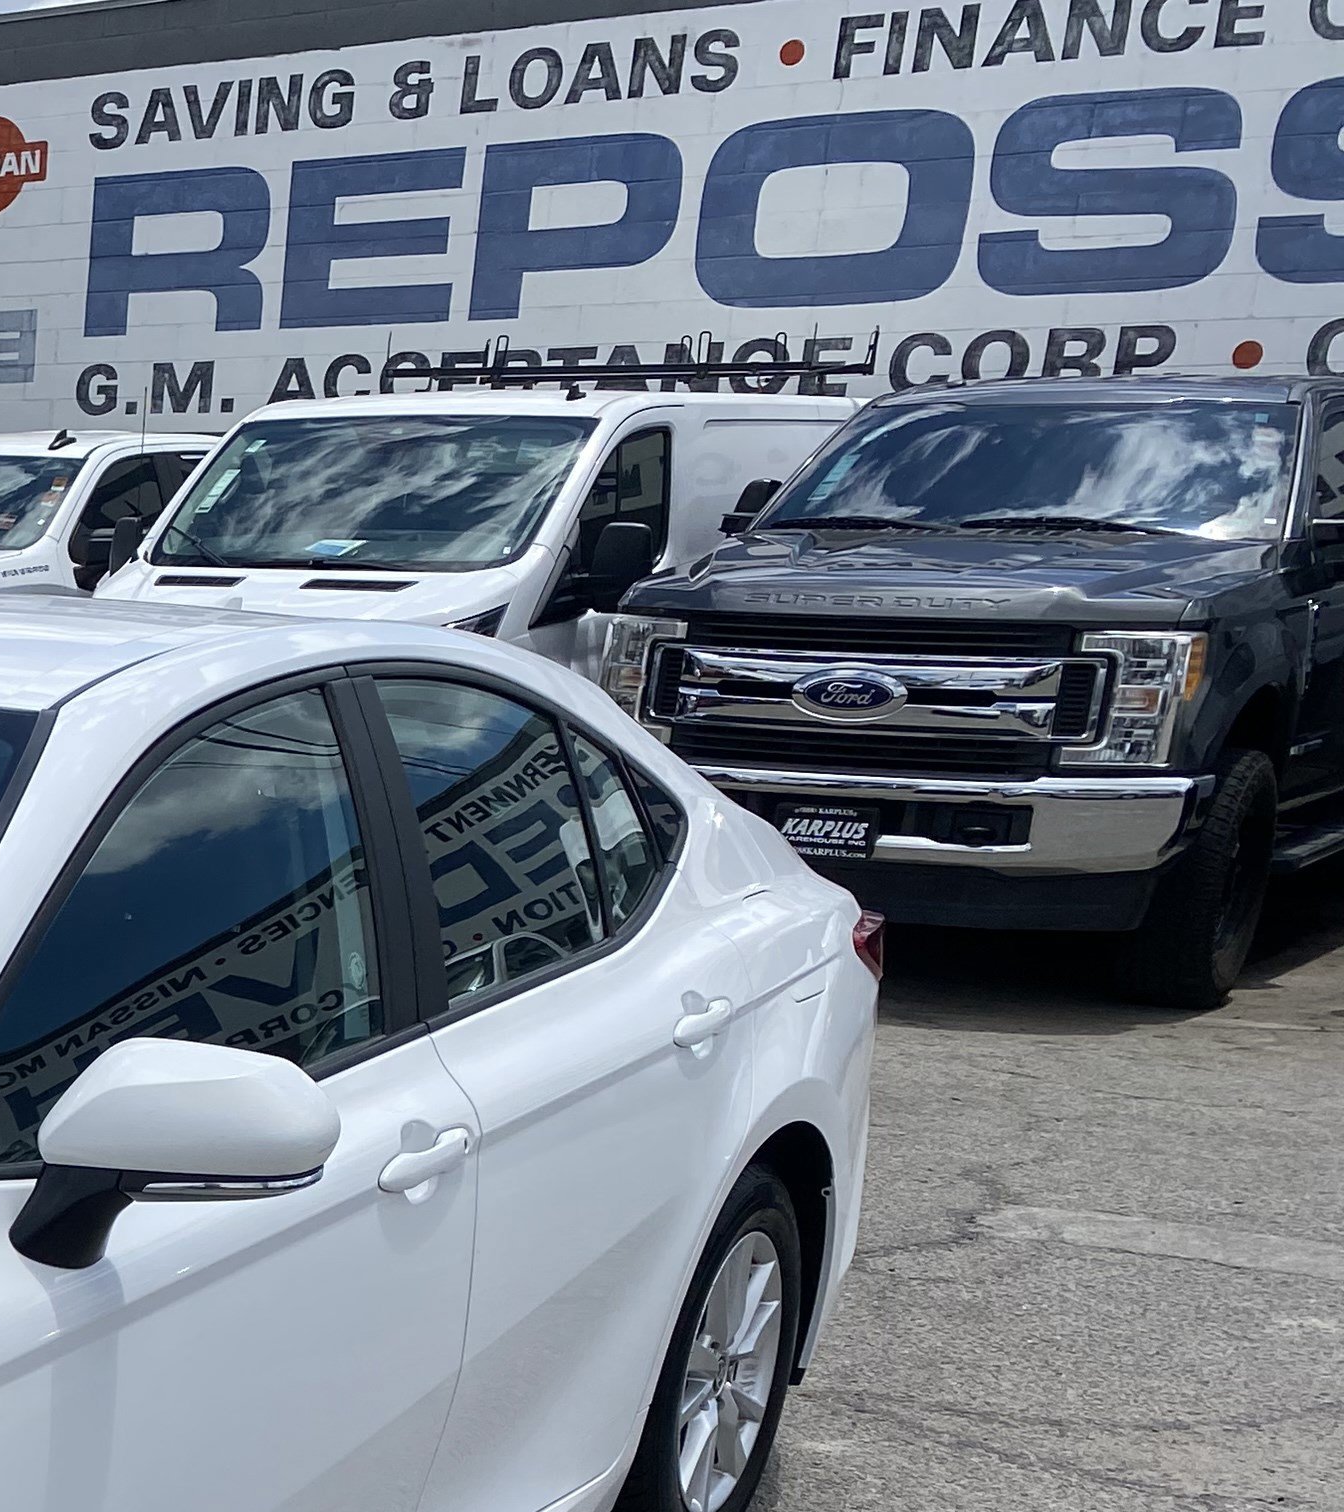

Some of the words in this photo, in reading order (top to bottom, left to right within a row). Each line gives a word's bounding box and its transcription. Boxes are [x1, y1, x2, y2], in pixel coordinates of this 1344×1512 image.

[89, 69, 356, 150] SAVING
[389, 60, 435, 120] &
[459, 29, 742, 116] LOANS
[832, 0, 1266, 80] FINANCE
[76, 360, 235, 416] G.M.
[743, 592, 884, 608] SUPER
[893, 596, 1013, 609] DUTY
[820, 682, 877, 705] Ford
[781, 818, 868, 839] KARPLUS
